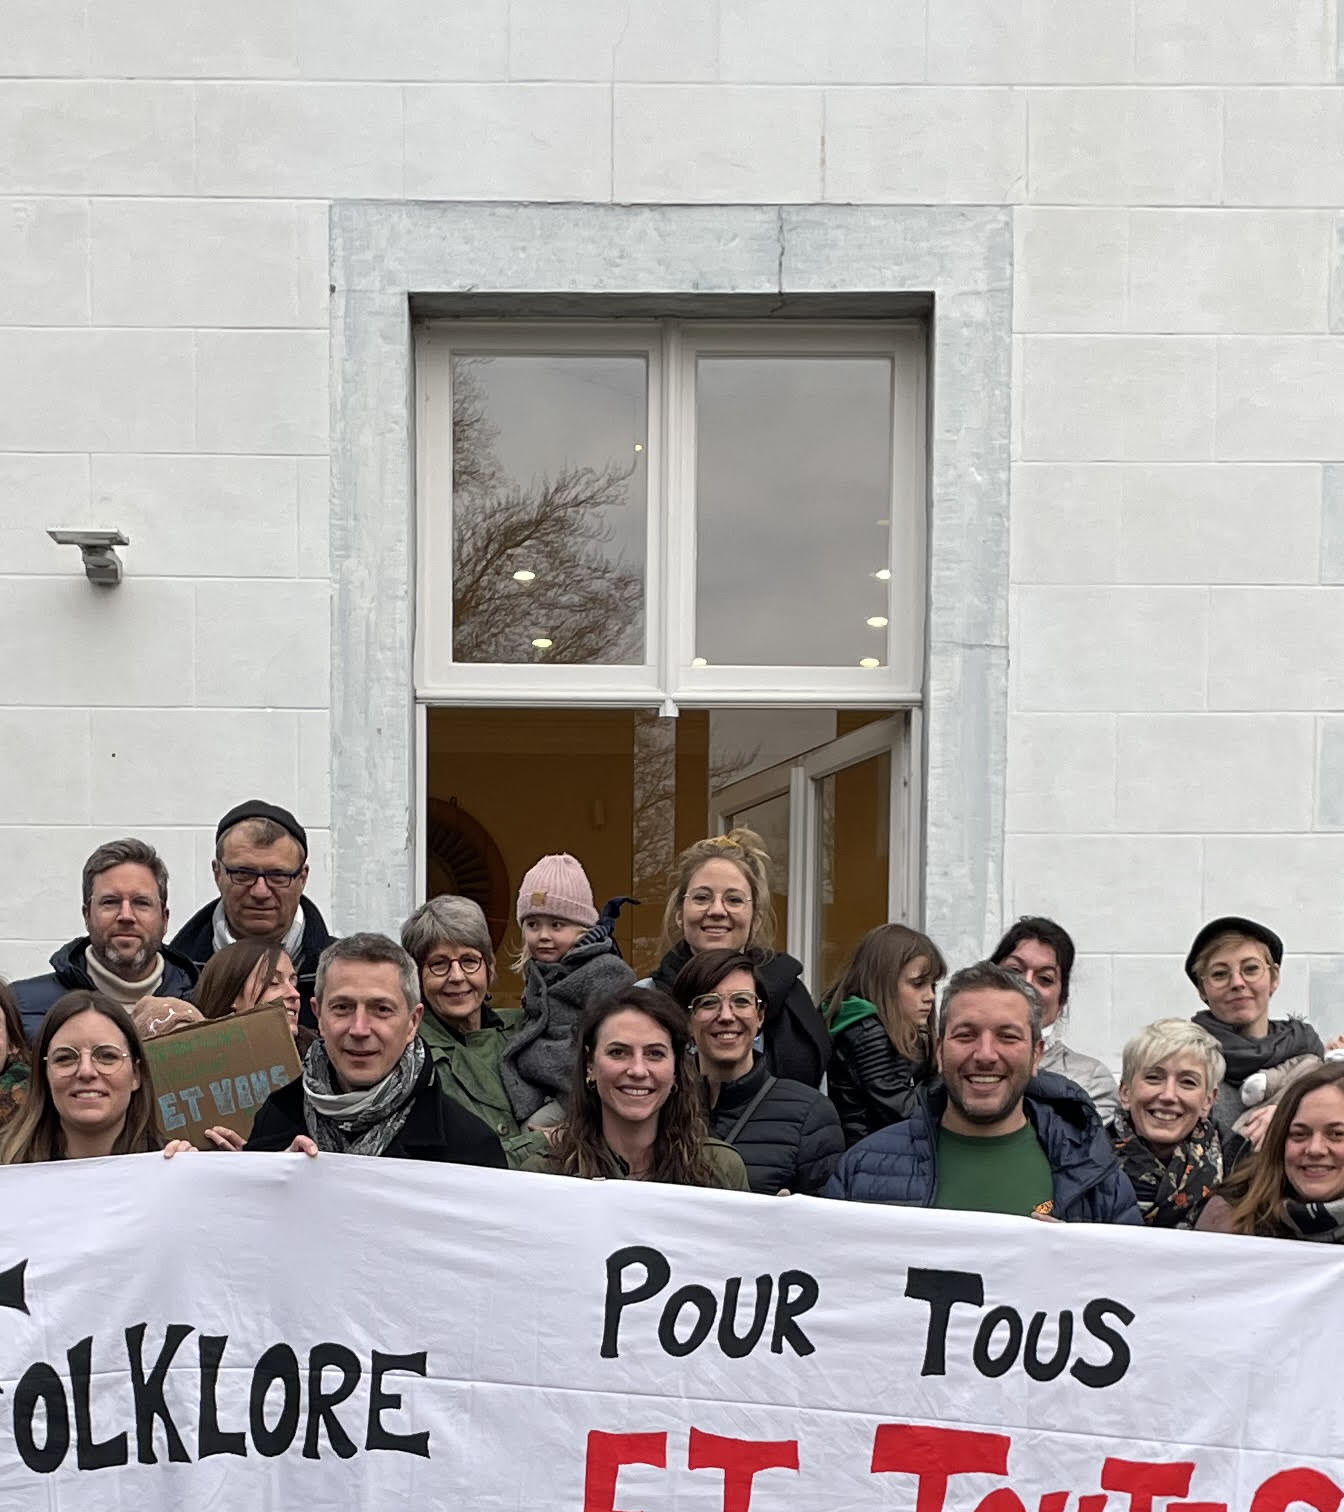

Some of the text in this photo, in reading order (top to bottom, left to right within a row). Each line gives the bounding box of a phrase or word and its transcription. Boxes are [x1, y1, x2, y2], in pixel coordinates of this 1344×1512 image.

[158, 1086, 205, 1131] ET
[601, 1246, 1134, 1388] POUR TOUS
